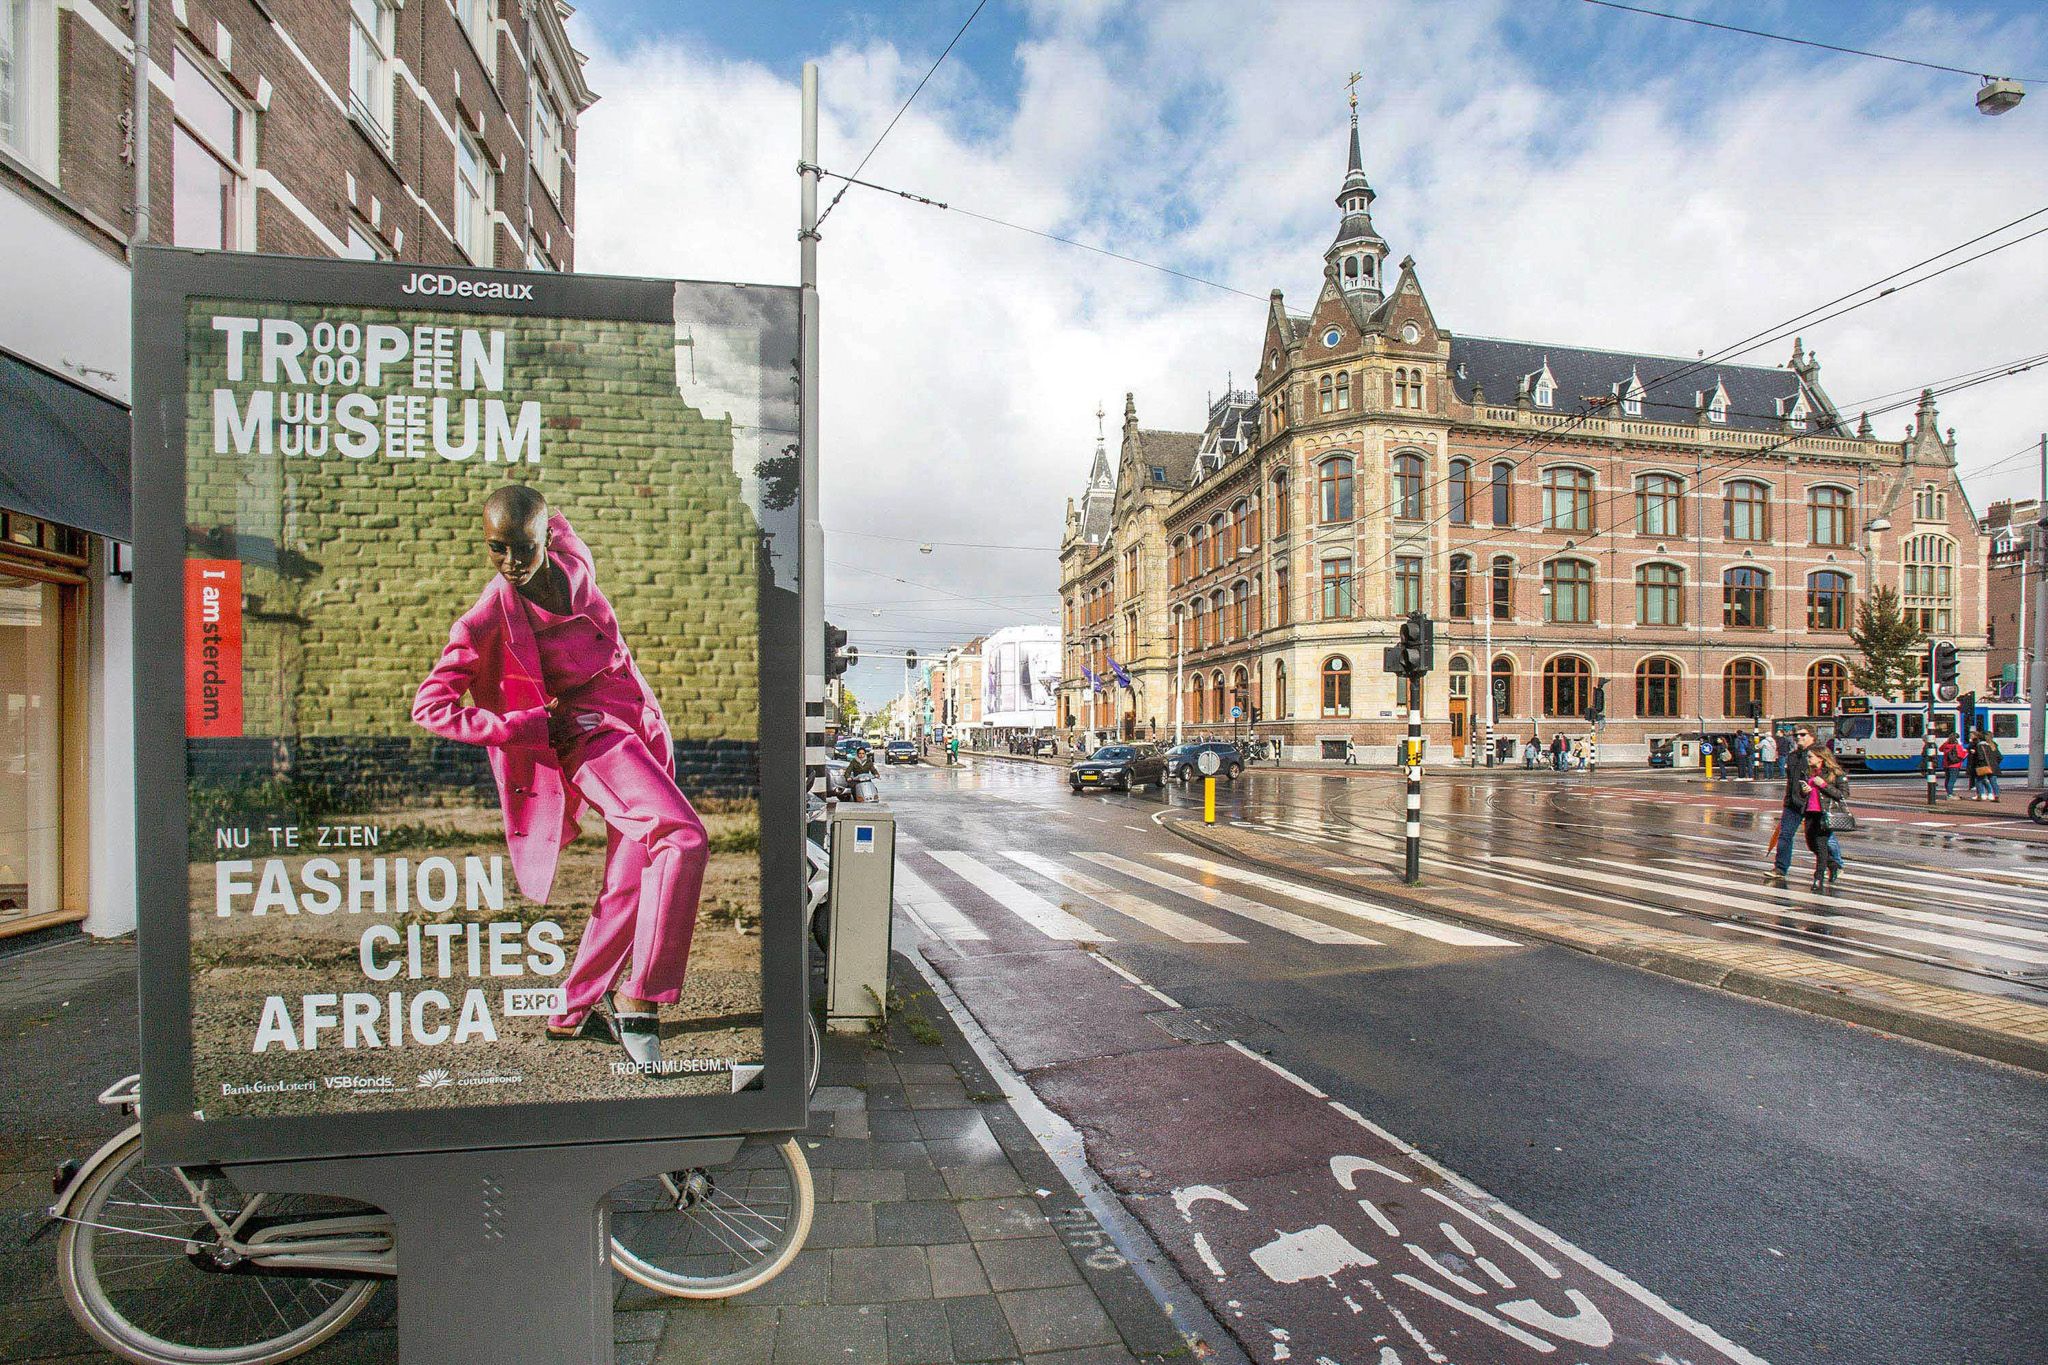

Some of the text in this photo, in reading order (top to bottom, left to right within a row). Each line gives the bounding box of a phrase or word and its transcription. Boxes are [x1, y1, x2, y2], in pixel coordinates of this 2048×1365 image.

[402, 273, 533, 300] JCDecaux
[203, 570, 226, 721] I amsterdam
[216, 826, 379, 849] NU TE ZIEN
[215, 856, 504, 917] FASHION
[359, 921, 566, 981] CITIES
[253, 988, 559, 1053] AFRICA EXPO
[222, 1080, 317, 1096] BankGiroLoterij
[457, 1076, 522, 1086] CULTUURFONDS
